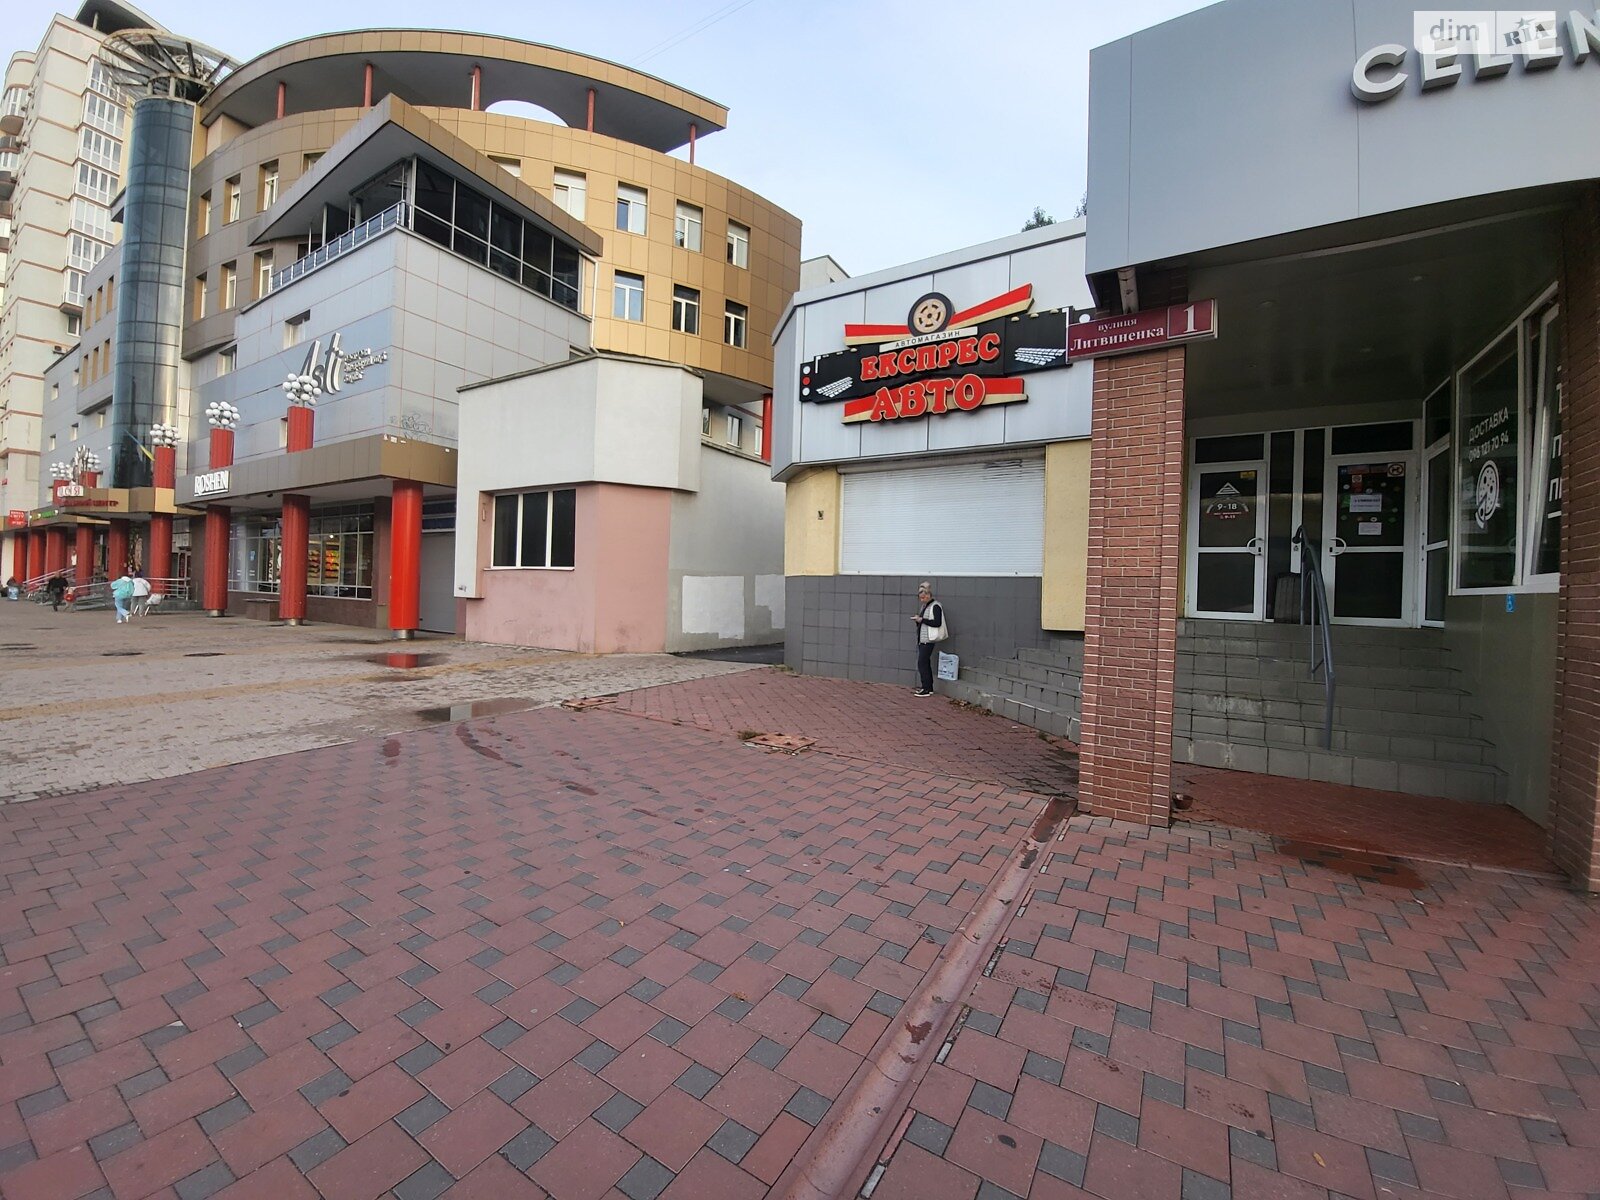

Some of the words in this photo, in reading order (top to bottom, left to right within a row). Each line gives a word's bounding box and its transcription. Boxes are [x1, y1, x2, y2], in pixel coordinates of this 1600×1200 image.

[895, 330, 961, 348] АВТОМАГАЗИН
[1070, 326, 1164, 351] Литвиненка
[1183, 304, 1198, 334] 1
[1098, 318, 1137, 333] вулиця
[860, 332, 1000, 381] ЕКСПРЕС
[869, 373, 986, 422] АВТО
[1469, 406, 1509, 445] ДОСТАВКА
[1491, 435, 1500, 451] 70
[1500, 430, 1509, 446] 94
[194, 470, 229, 496] ROSHEN
